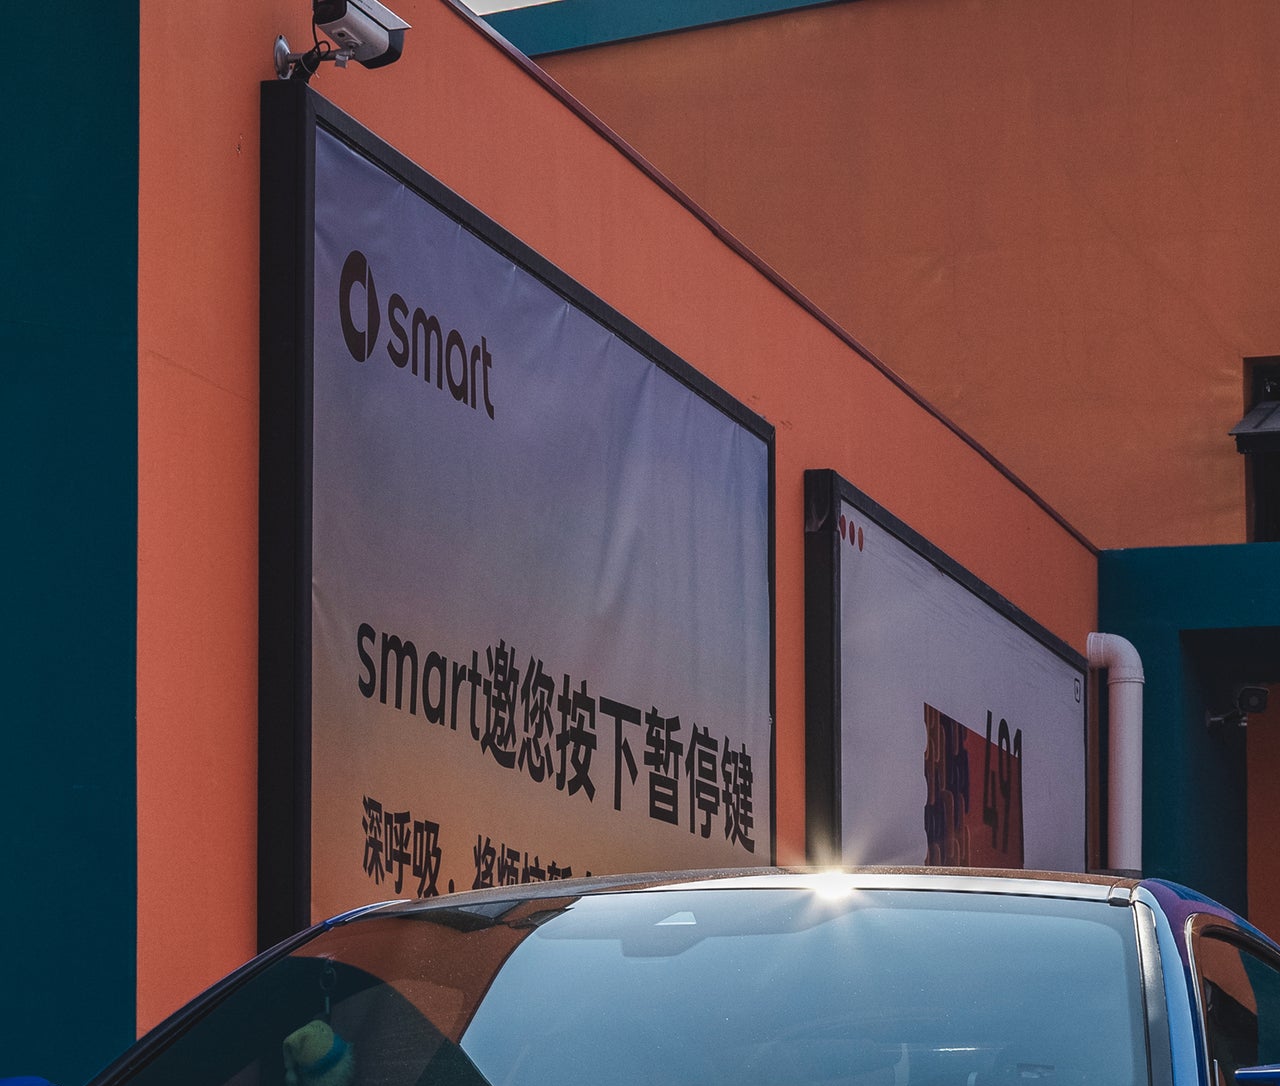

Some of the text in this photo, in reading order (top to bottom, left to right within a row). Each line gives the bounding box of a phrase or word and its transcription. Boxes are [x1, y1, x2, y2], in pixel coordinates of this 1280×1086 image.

[386, 292, 495, 421] smart
[356, 622, 755, 855] smart邀您按下暂停键
